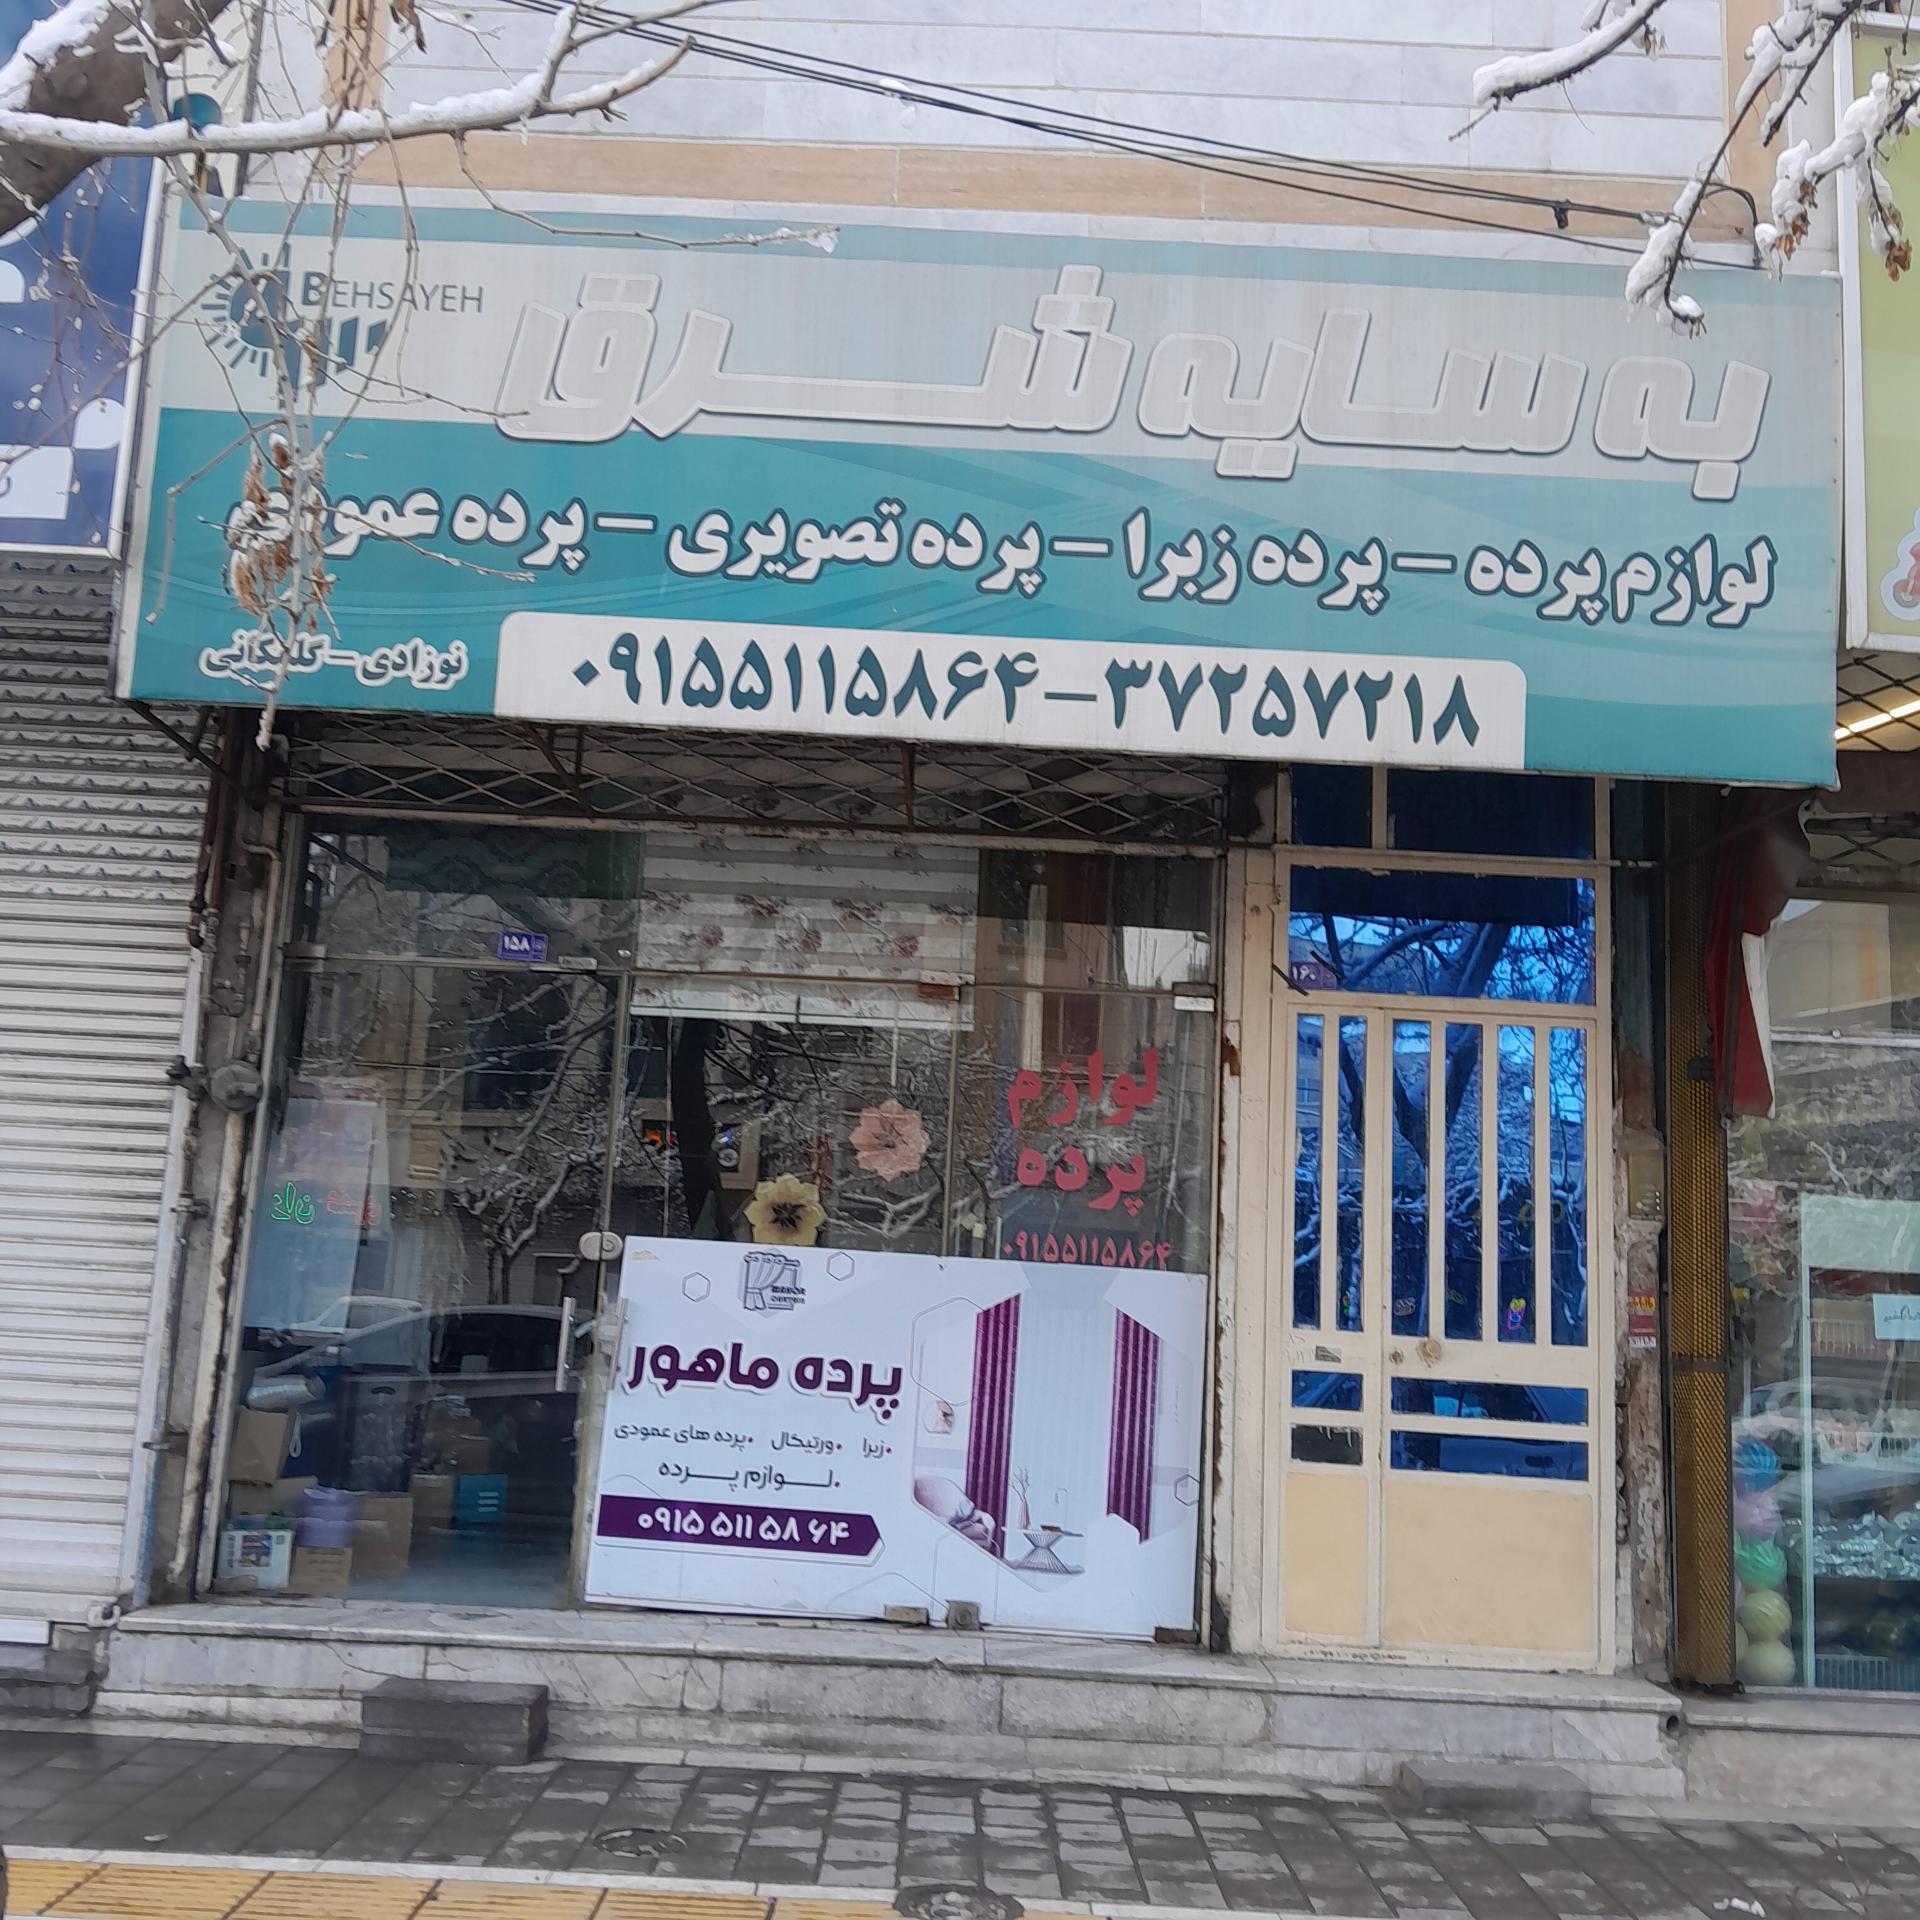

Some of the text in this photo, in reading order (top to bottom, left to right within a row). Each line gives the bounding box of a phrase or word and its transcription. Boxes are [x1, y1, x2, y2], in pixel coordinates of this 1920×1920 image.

[302, 271, 483, 314] BEHSAYEH
[494, 264, 1772, 500] به سایه شرق
[450, 490, 588, 574] پرده
[665, 496, 906, 581] تصویری
[908, 513, 1046, 599] پرده
[1123, 506, 1241, 603] زبرا
[1247, 528, 1389, 615] پرده
[1465, 539, 1608, 625] پرده
[1611, 533, 1779, 628] لوازم
[503, 935, 530, 952] ۱۵۸
[1007, 1047, 1161, 1129] لوازم
[1016, 1145, 1147, 1217] پرده
[1002, 1230, 1173, 1270] ۰۹۱۵۵۱۱۵۸۶۴
[626, 1342, 904, 1420] پرده ماهور
[613, 1422, 885, 1459] زبرا ورتیکال پرده های عمودی
[657, 1459, 834, 1492] لوازم پرده
[637, 1506, 850, 1546] ۰۹۱۵ ۵۱۱ ۵۸ ۶۴
